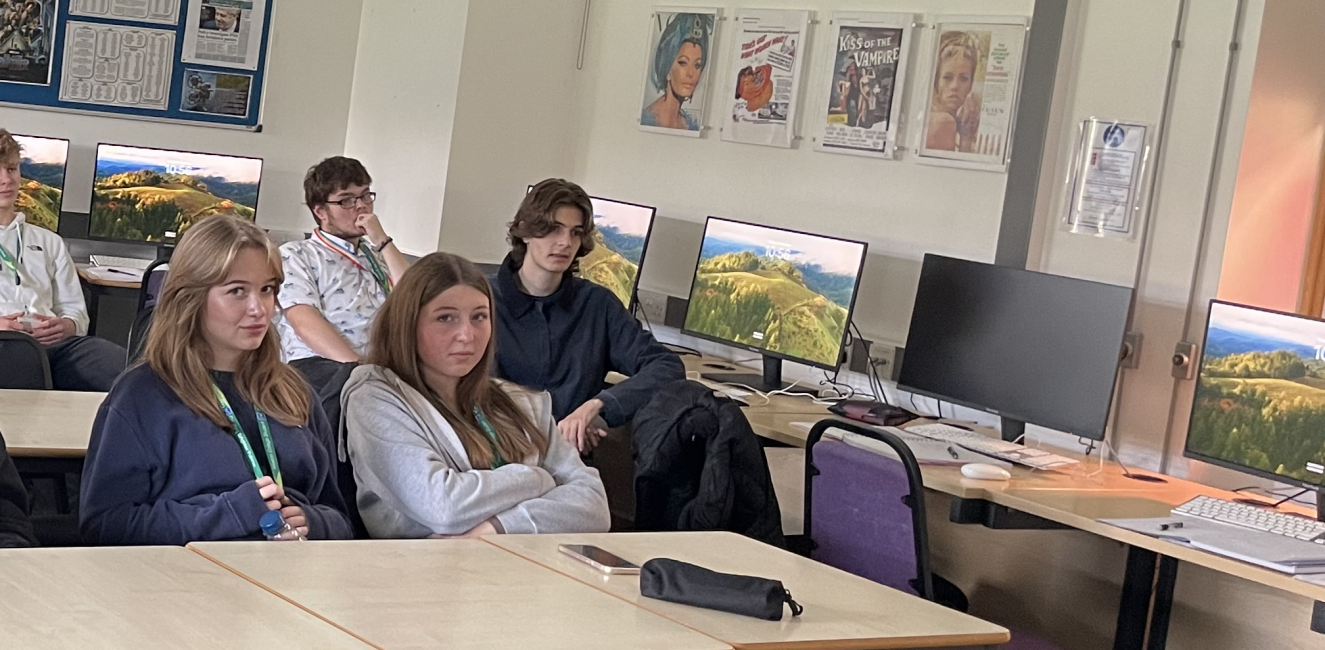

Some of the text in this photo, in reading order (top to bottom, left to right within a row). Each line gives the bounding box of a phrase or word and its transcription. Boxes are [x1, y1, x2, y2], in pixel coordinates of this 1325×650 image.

[839, 35, 892, 52] KISS OF THE
[853, 47, 899, 68] VAMPIRE
[765, 246, 792, 261] 10:56
